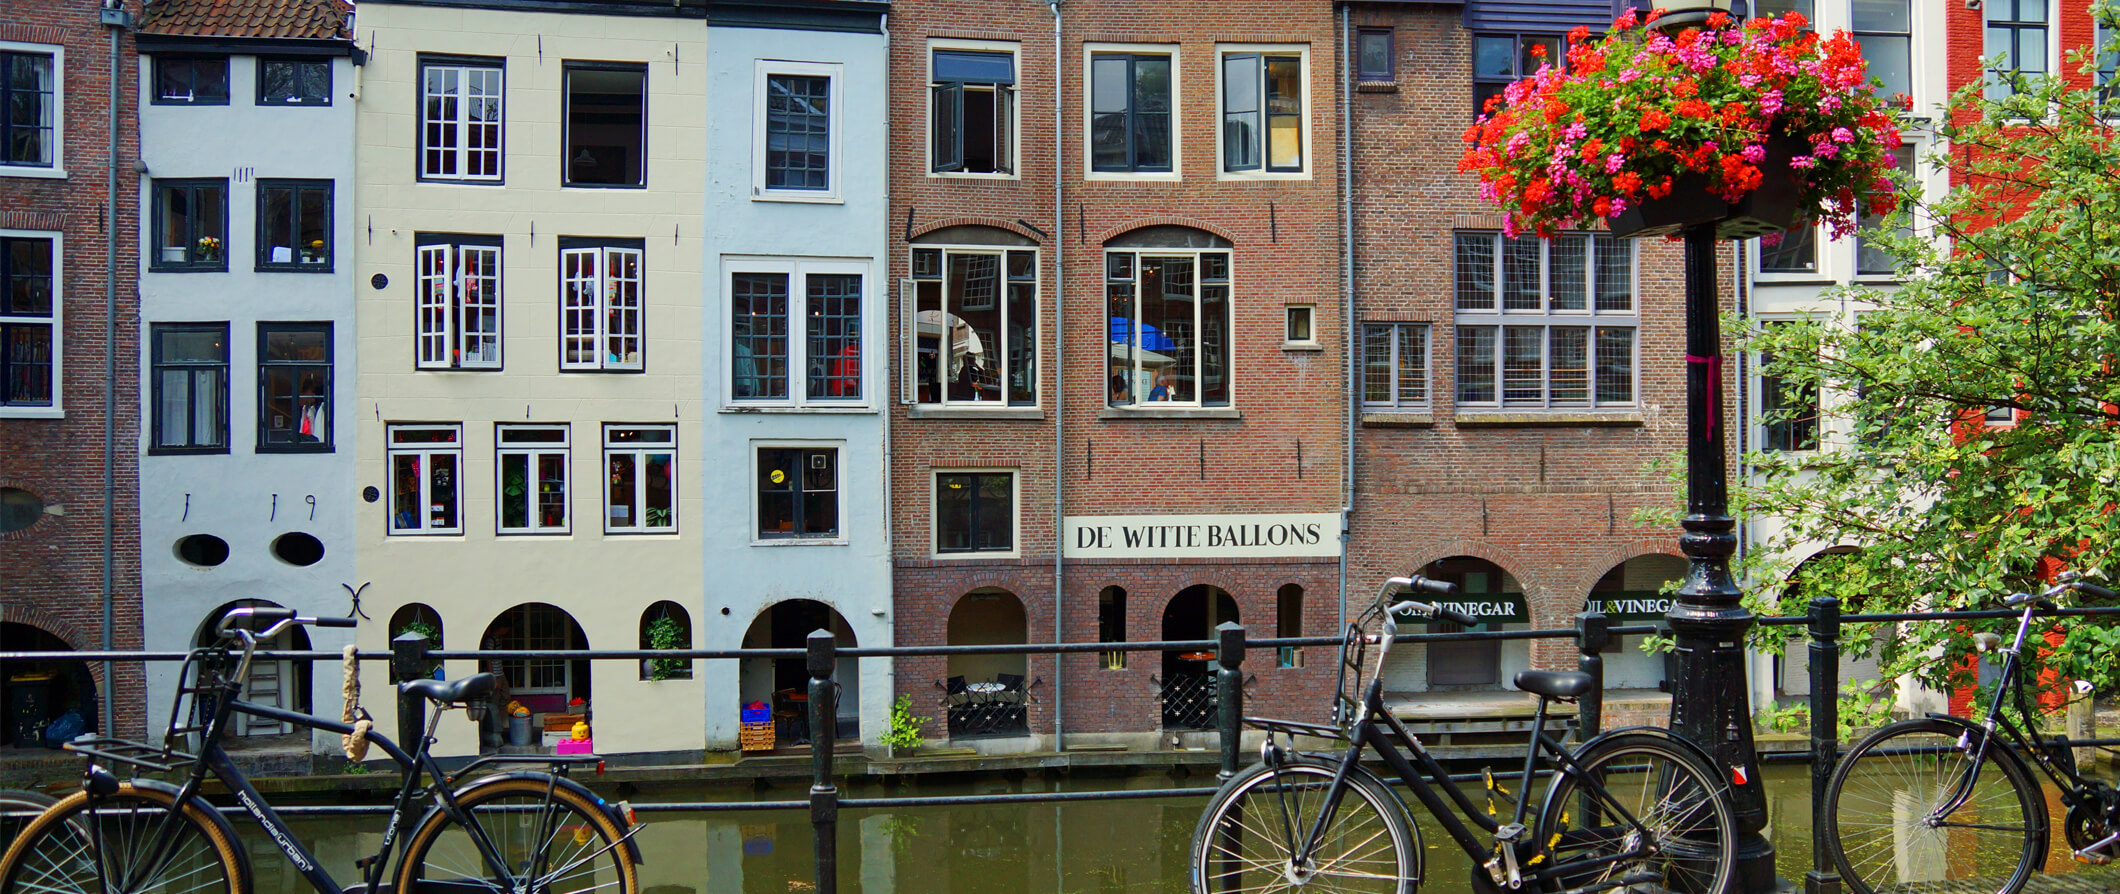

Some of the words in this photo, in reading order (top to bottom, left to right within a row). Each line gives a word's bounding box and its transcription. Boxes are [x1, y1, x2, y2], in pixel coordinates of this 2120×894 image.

[1077, 526, 1112, 548] DE
[1122, 525, 1201, 548] WITTE
[1207, 523, 1321, 547] BALLONS
[237, 789, 279, 837] hollandia
[276, 834, 308, 869] urban
